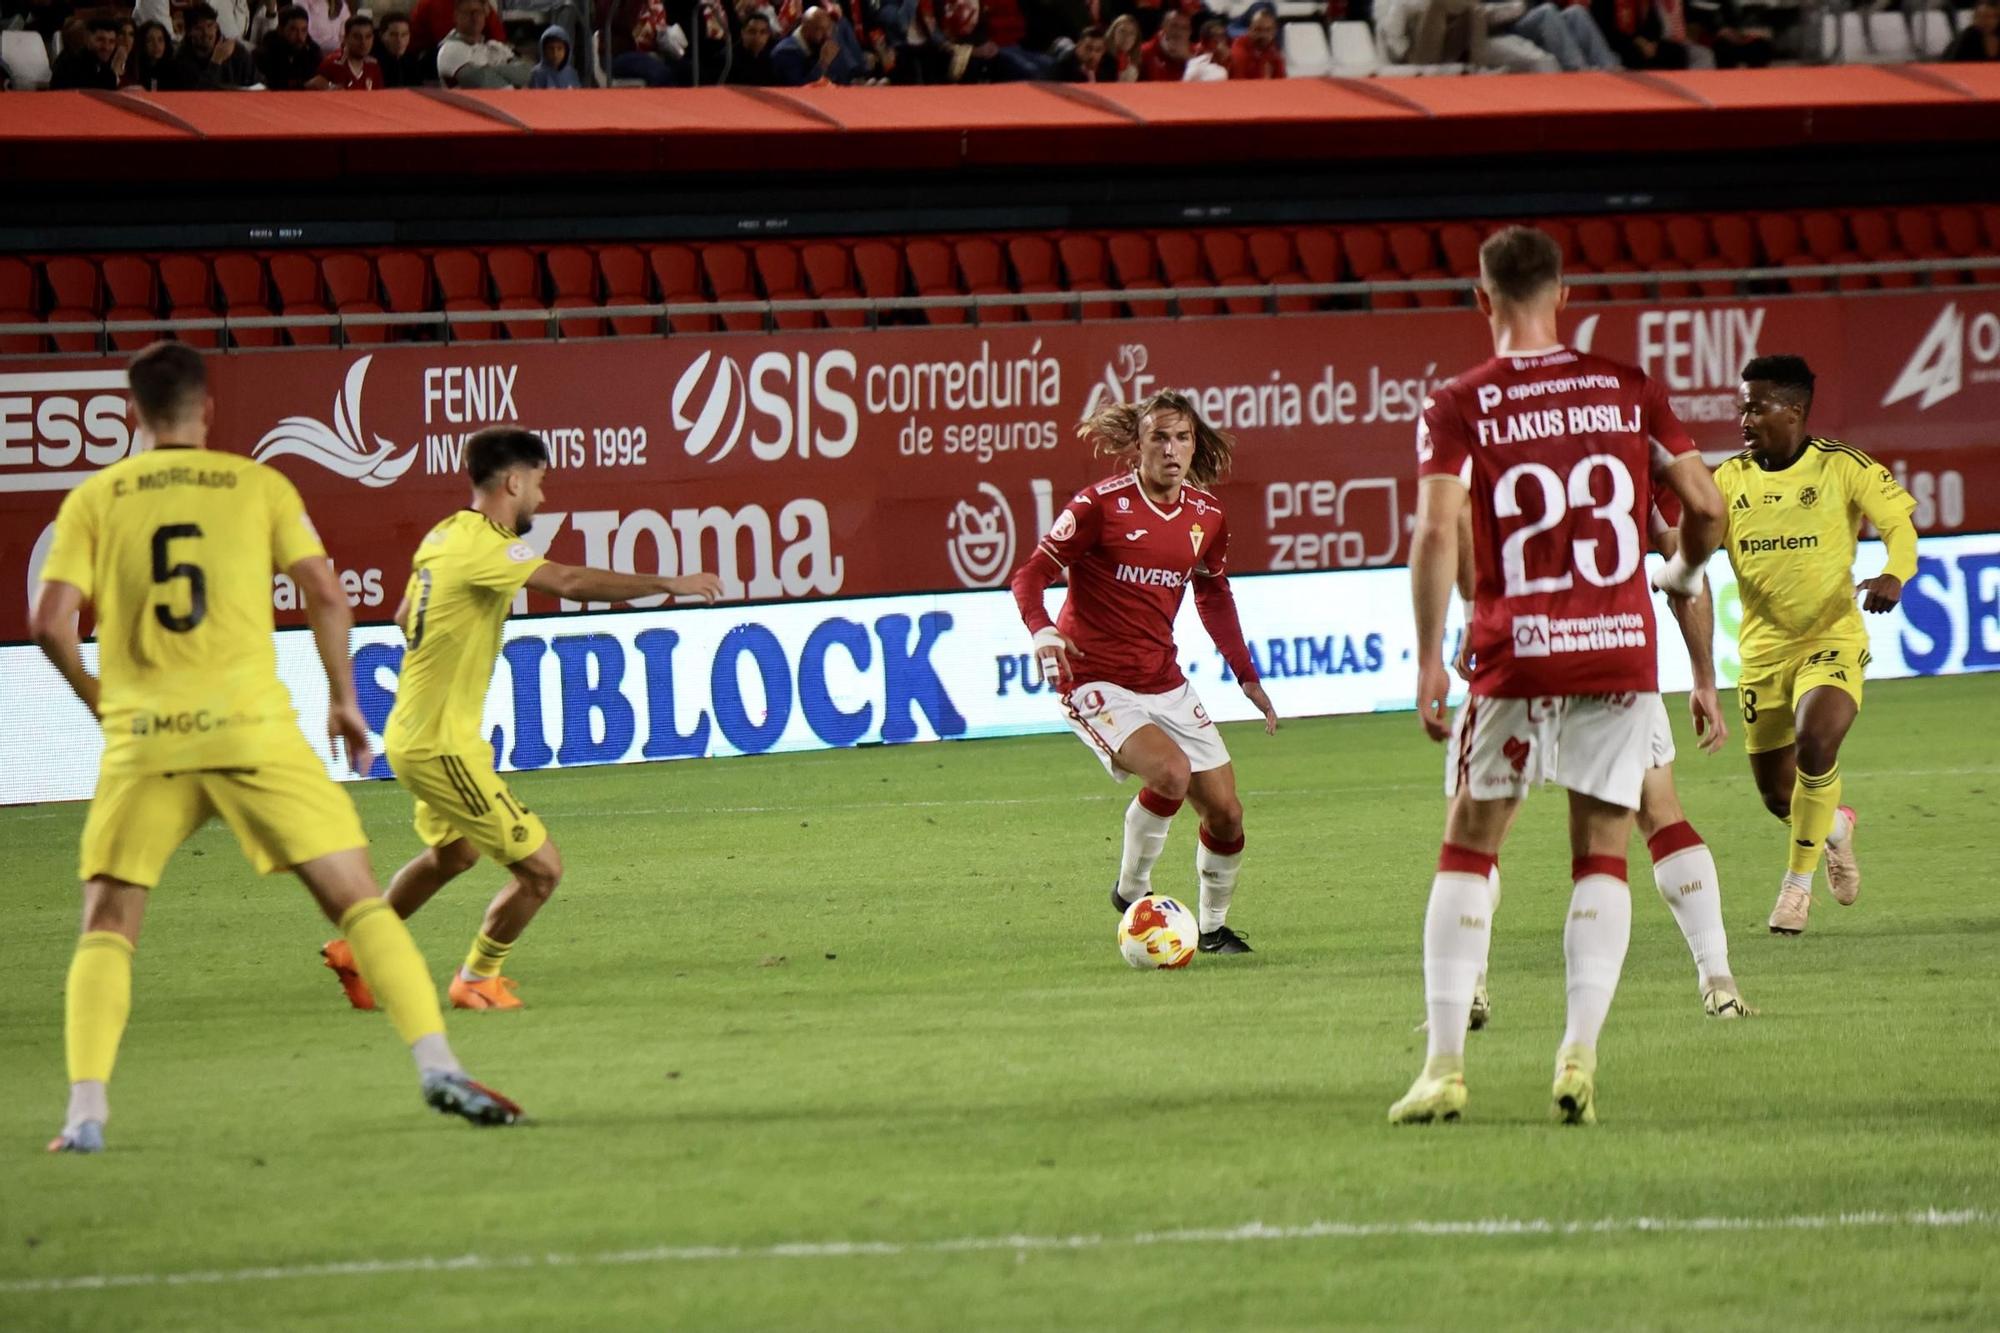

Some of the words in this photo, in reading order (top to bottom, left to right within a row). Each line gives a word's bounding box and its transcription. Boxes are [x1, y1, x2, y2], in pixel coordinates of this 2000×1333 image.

[1639, 308, 1766, 391] FENIX
[424, 365, 518, 424] FENIX
[749, 349, 858, 461] SIS
[866, 338, 1061, 414] correduría
[1135, 369, 1300, 430] Fneraria
[1309, 364, 1356, 426] de
[1362, 361, 1452, 423] Jesú
[0, 395, 146, 467] ESS
[426, 428, 585, 475] INVNTS
[593, 427, 647, 468] 1992
[900, 416, 933, 456] de
[944, 420, 1058, 463] seguros
[1477, 409, 1565, 447] FLAKUS
[1567, 405, 1642, 435] BOSILJ
[1266, 480, 1337, 530] pre
[1493, 453, 1641, 598] 23
[1268, 531, 1365, 571] zero
[1750, 534, 1819, 555] parlem
[151, 523, 207, 634] 5
